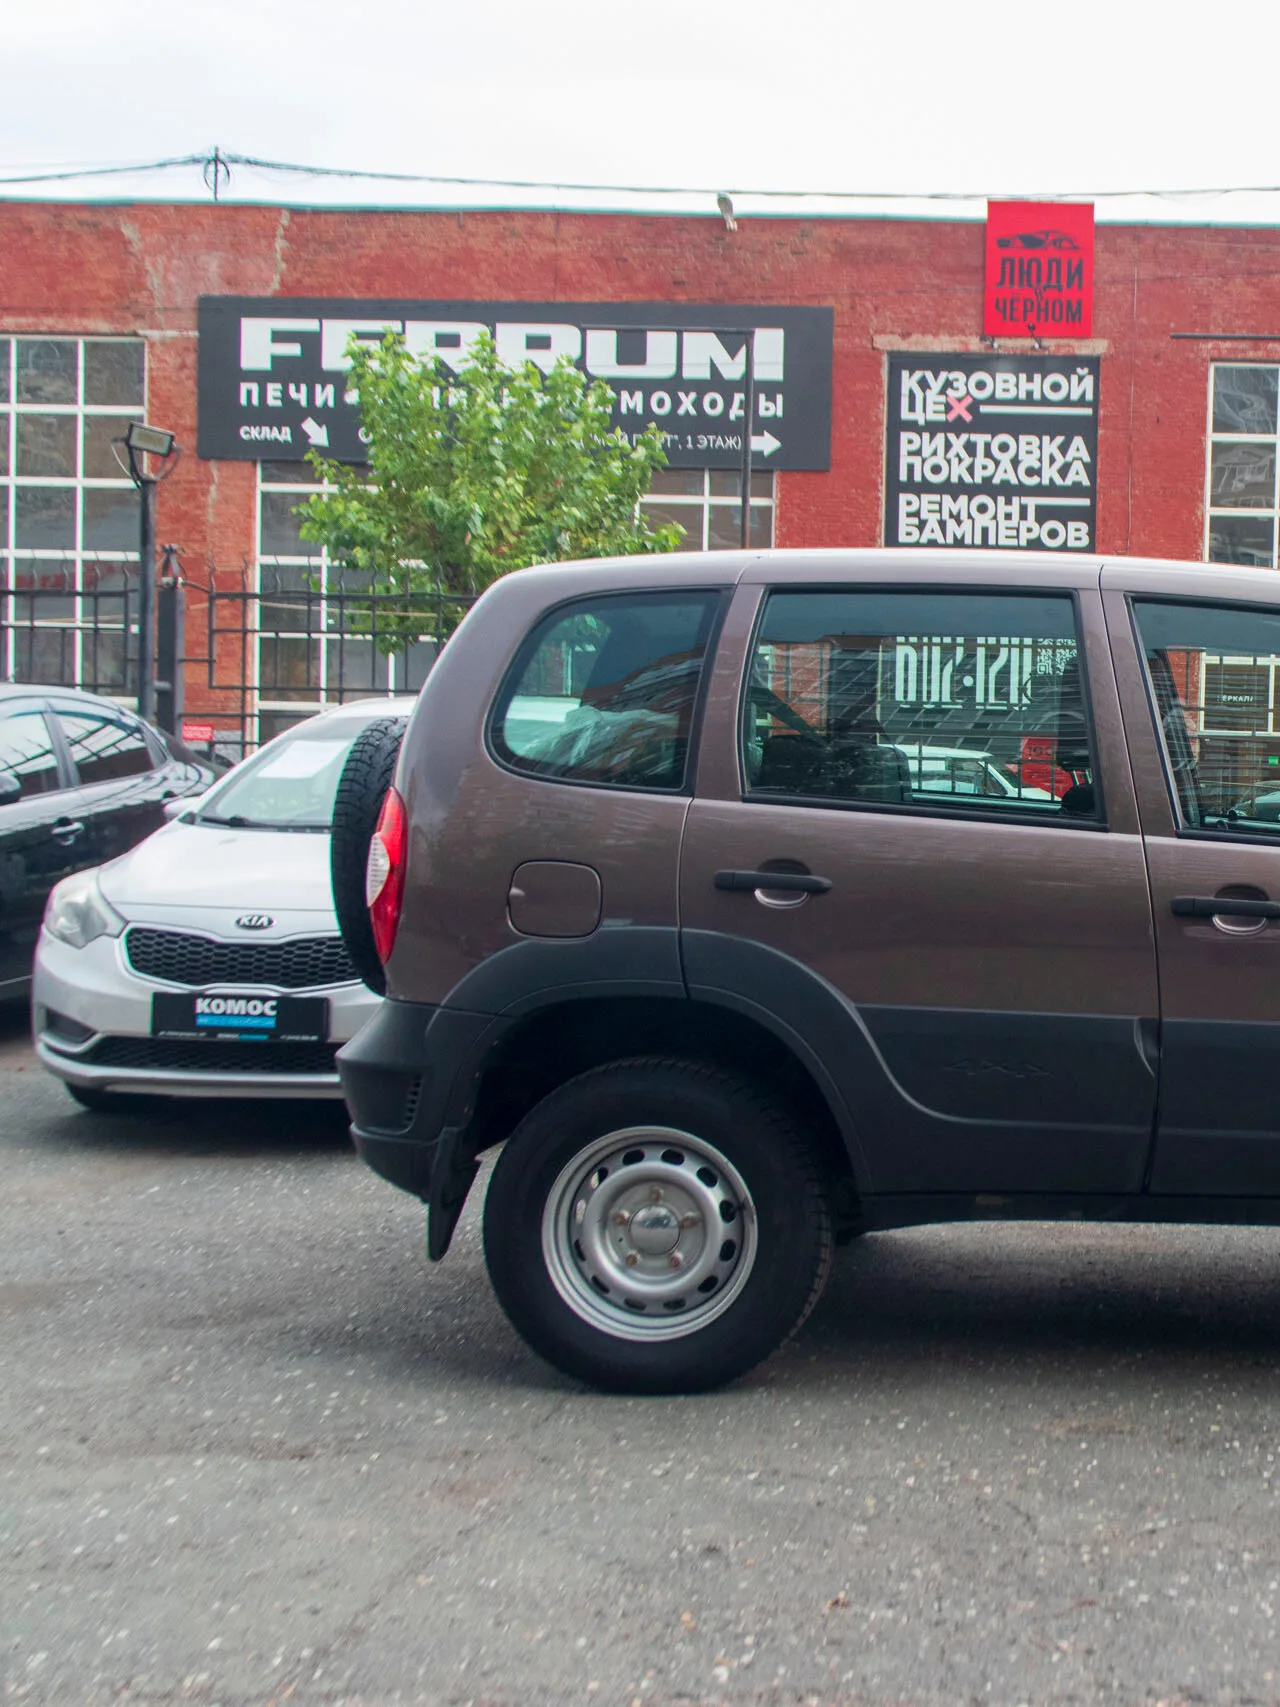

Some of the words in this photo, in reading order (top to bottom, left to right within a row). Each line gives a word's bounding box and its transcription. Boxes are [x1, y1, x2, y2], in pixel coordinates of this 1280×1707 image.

[996, 256, 1083, 293] ЛЮДИ
[240, 317, 784, 381] FERRUM
[901, 367, 1094, 402] КУЗОВНОЙ
[239, 382, 336, 408] ПЕЧИ
[572, 386, 784, 421] МОХОДЫ
[900, 394, 974, 425] ЦЕХ
[239, 425, 292, 443] СКЛАД
[696, 434, 742, 450] ЭТАЖ)
[900, 431, 1091, 463] РИХТОВКА
[899, 455, 1091, 487] ПОКРАСКА
[899, 493, 1036, 523] РЕМОНТ
[898, 516, 1090, 548] БАМПЕРОВ
[1216, 694, 1254, 703] ЕРКАЛ
[237, 915, 270, 927] KIA
[196, 998, 278, 1016] КОМОС
